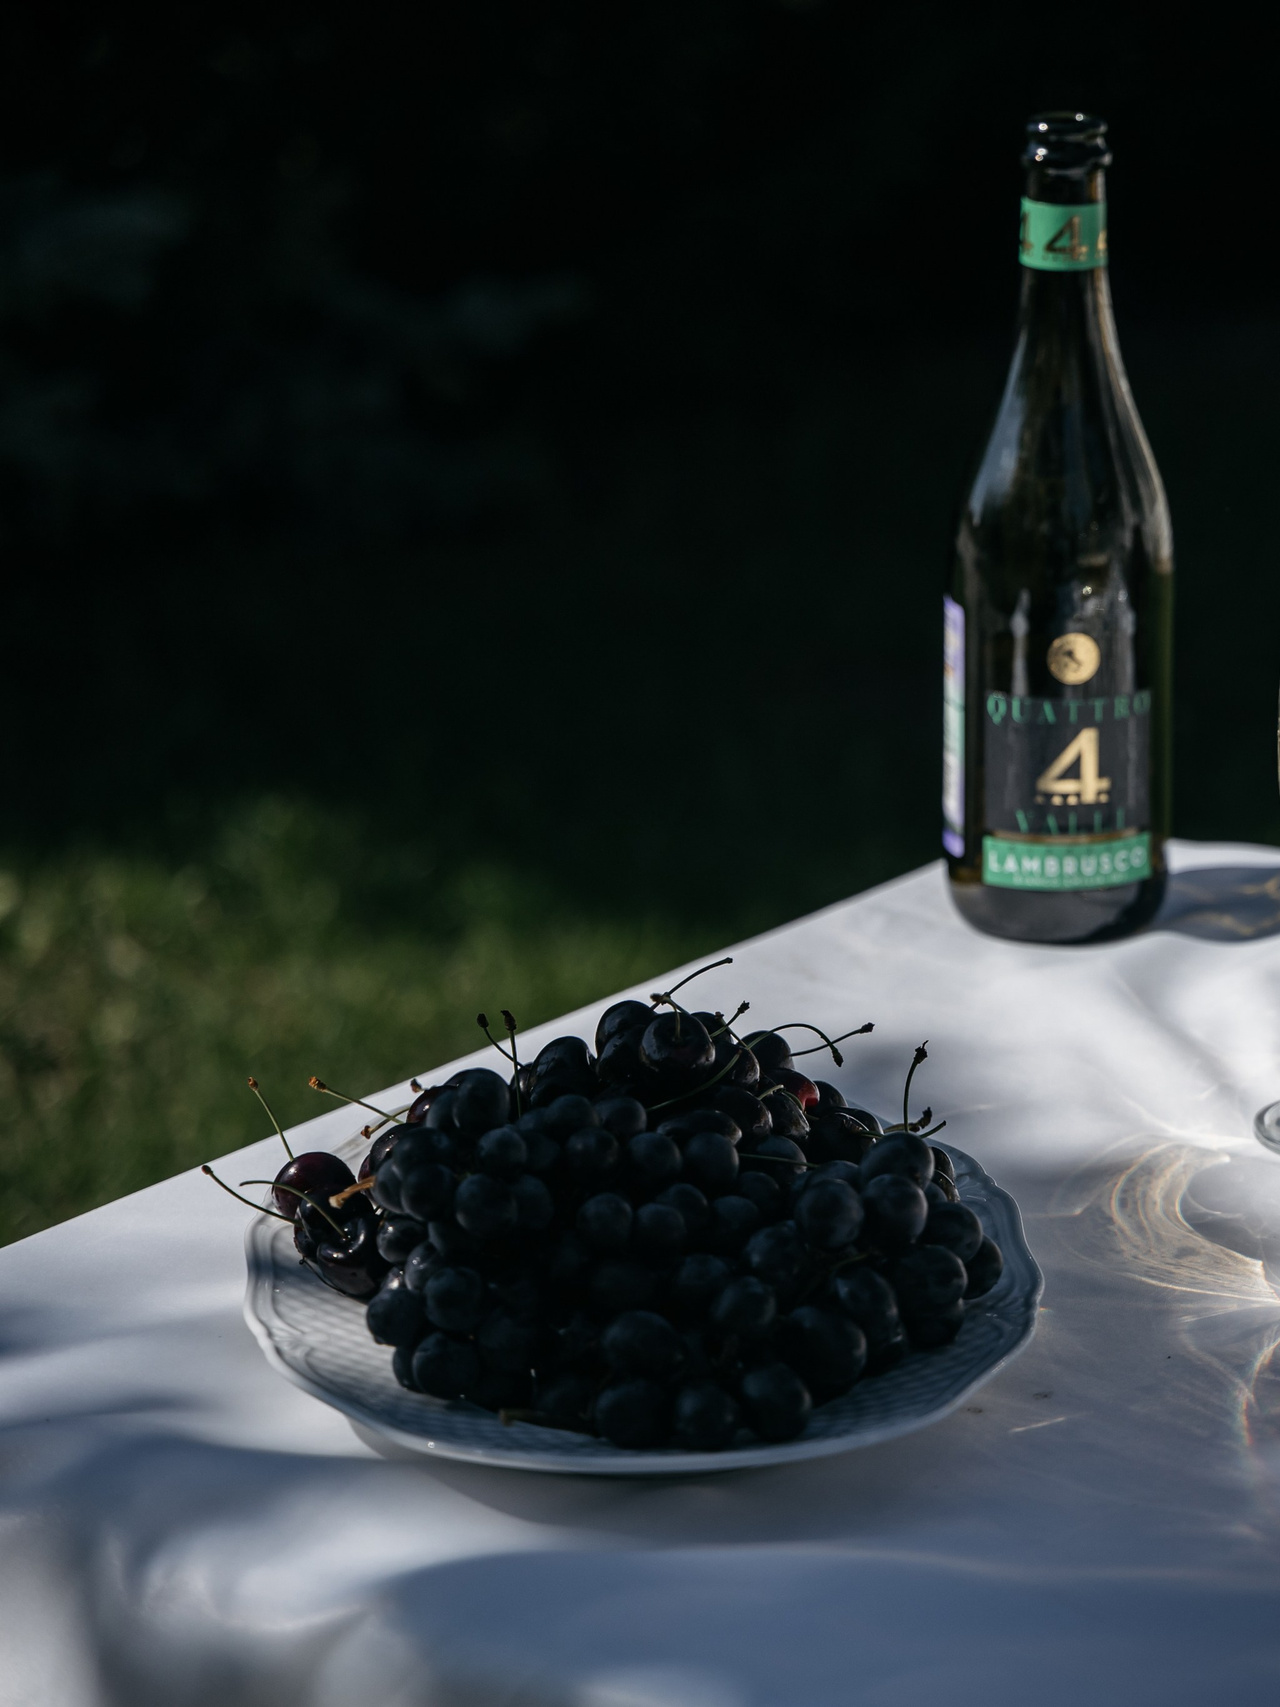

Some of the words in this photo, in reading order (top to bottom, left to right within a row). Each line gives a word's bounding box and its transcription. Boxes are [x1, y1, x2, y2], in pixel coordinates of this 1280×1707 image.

[1046, 216, 1088, 259] 4
[987, 692, 1151, 725] QUATTRO
[1036, 727, 1111, 805] 4
[988, 847, 1148, 876] LAMBRUSCO
